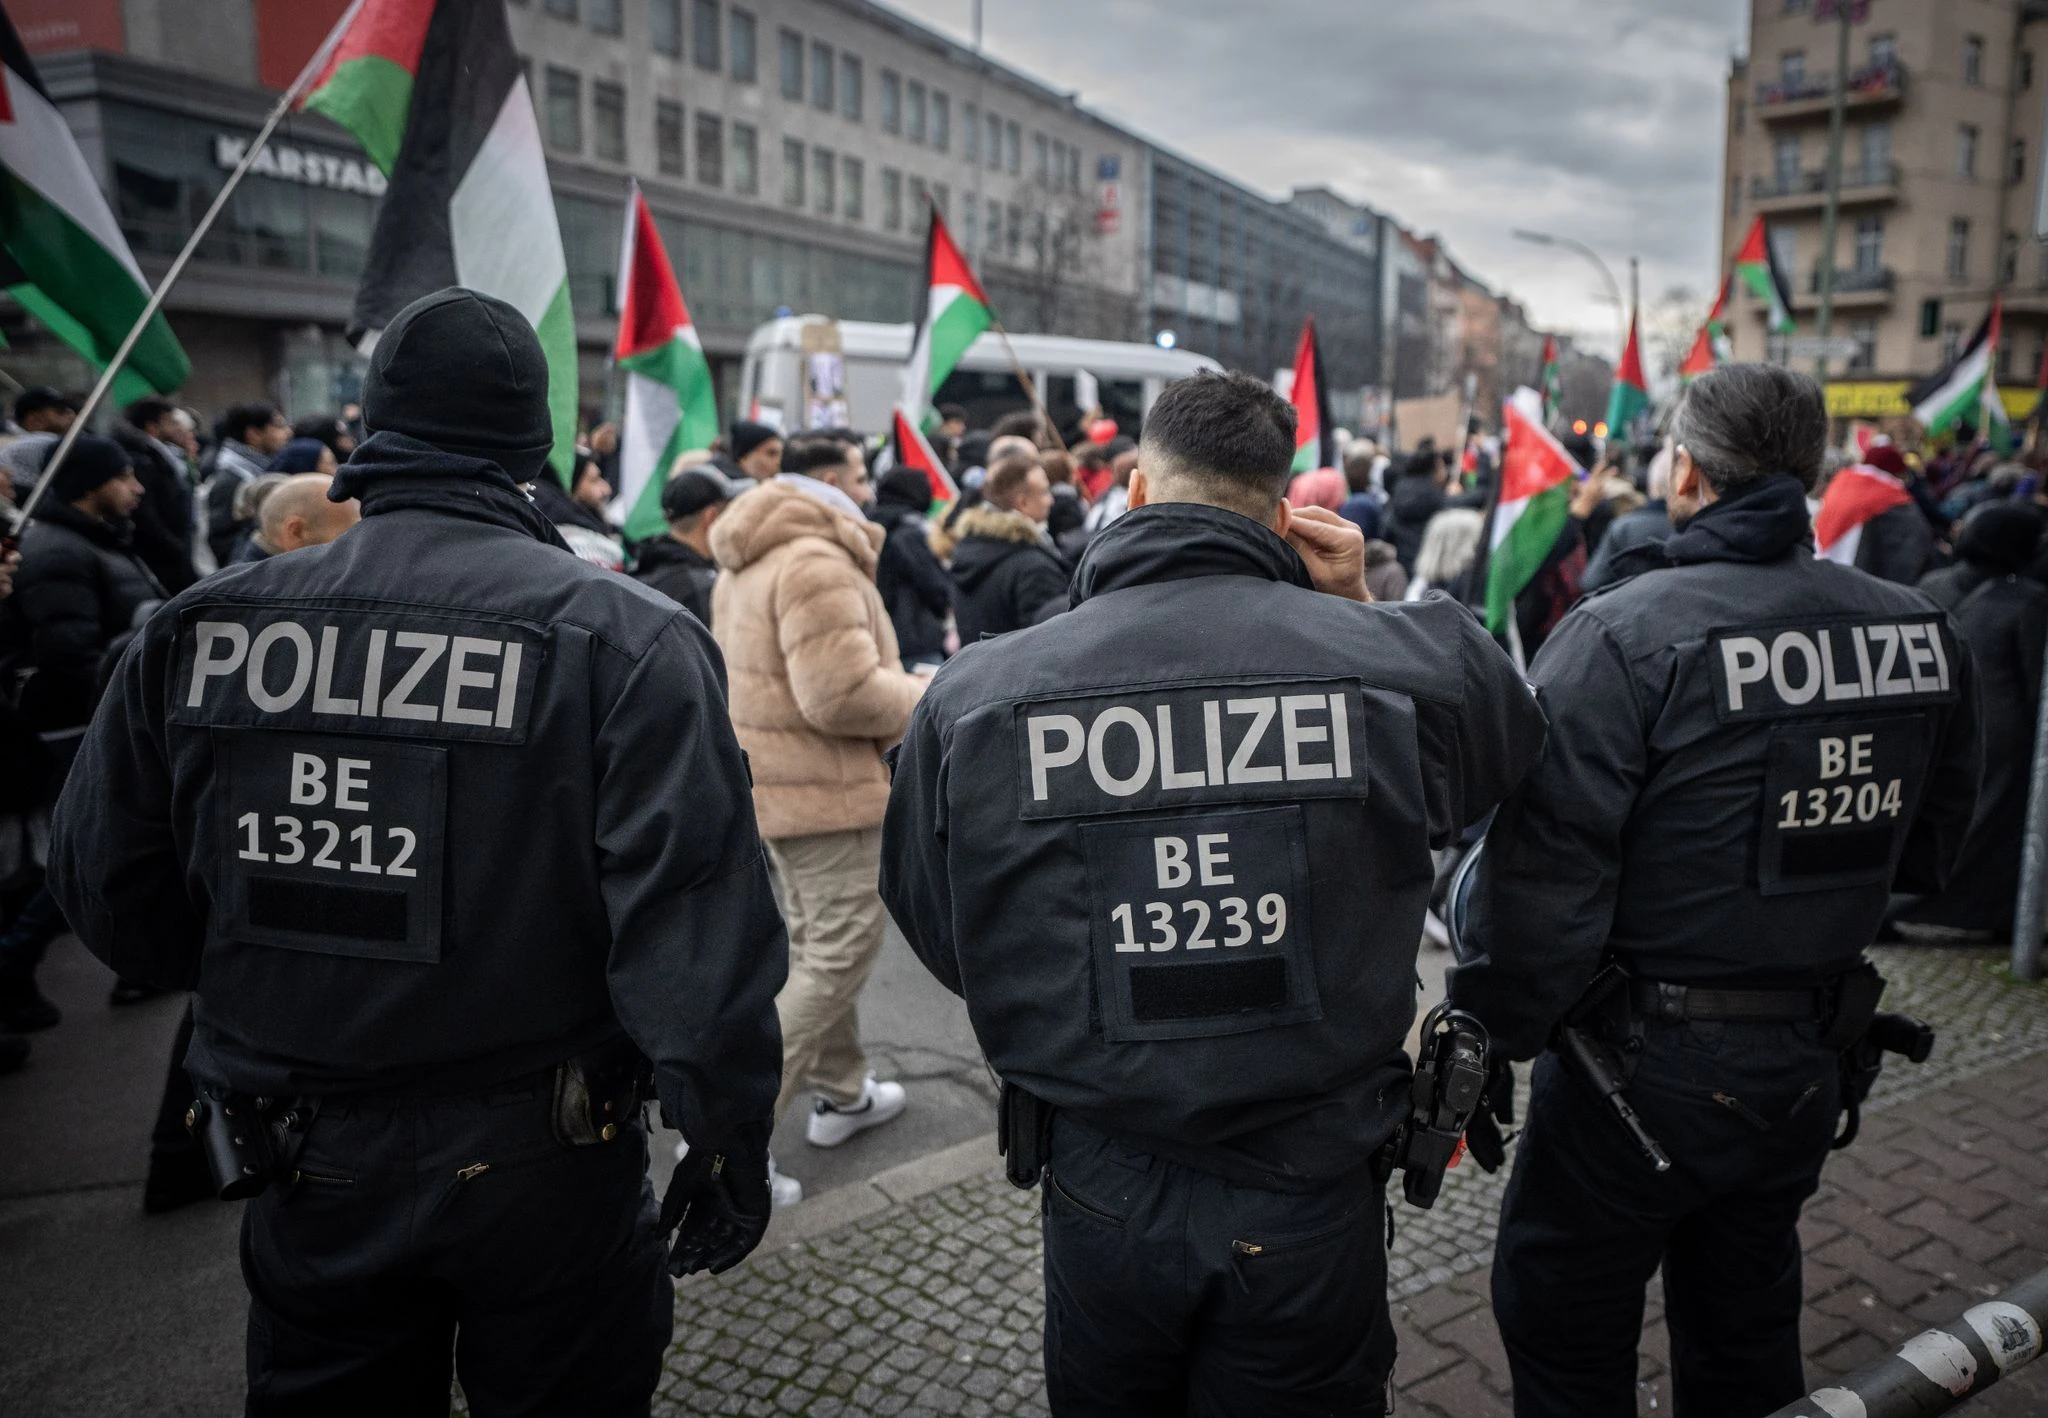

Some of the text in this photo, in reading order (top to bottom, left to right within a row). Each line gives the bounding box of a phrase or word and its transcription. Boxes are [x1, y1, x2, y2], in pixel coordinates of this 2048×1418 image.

[187, 622, 523, 729] POLIZEI
[1720, 622, 1951, 711] POLIZEI
[1027, 693, 1353, 801] POLIZEI
[1819, 733, 1874, 780] BE
[290, 752, 371, 812] BE
[1777, 779, 1902, 829] 13204
[237, 812, 417, 878] 13212
[1154, 833, 1235, 889] BE
[1111, 893, 1287, 953] 13239
